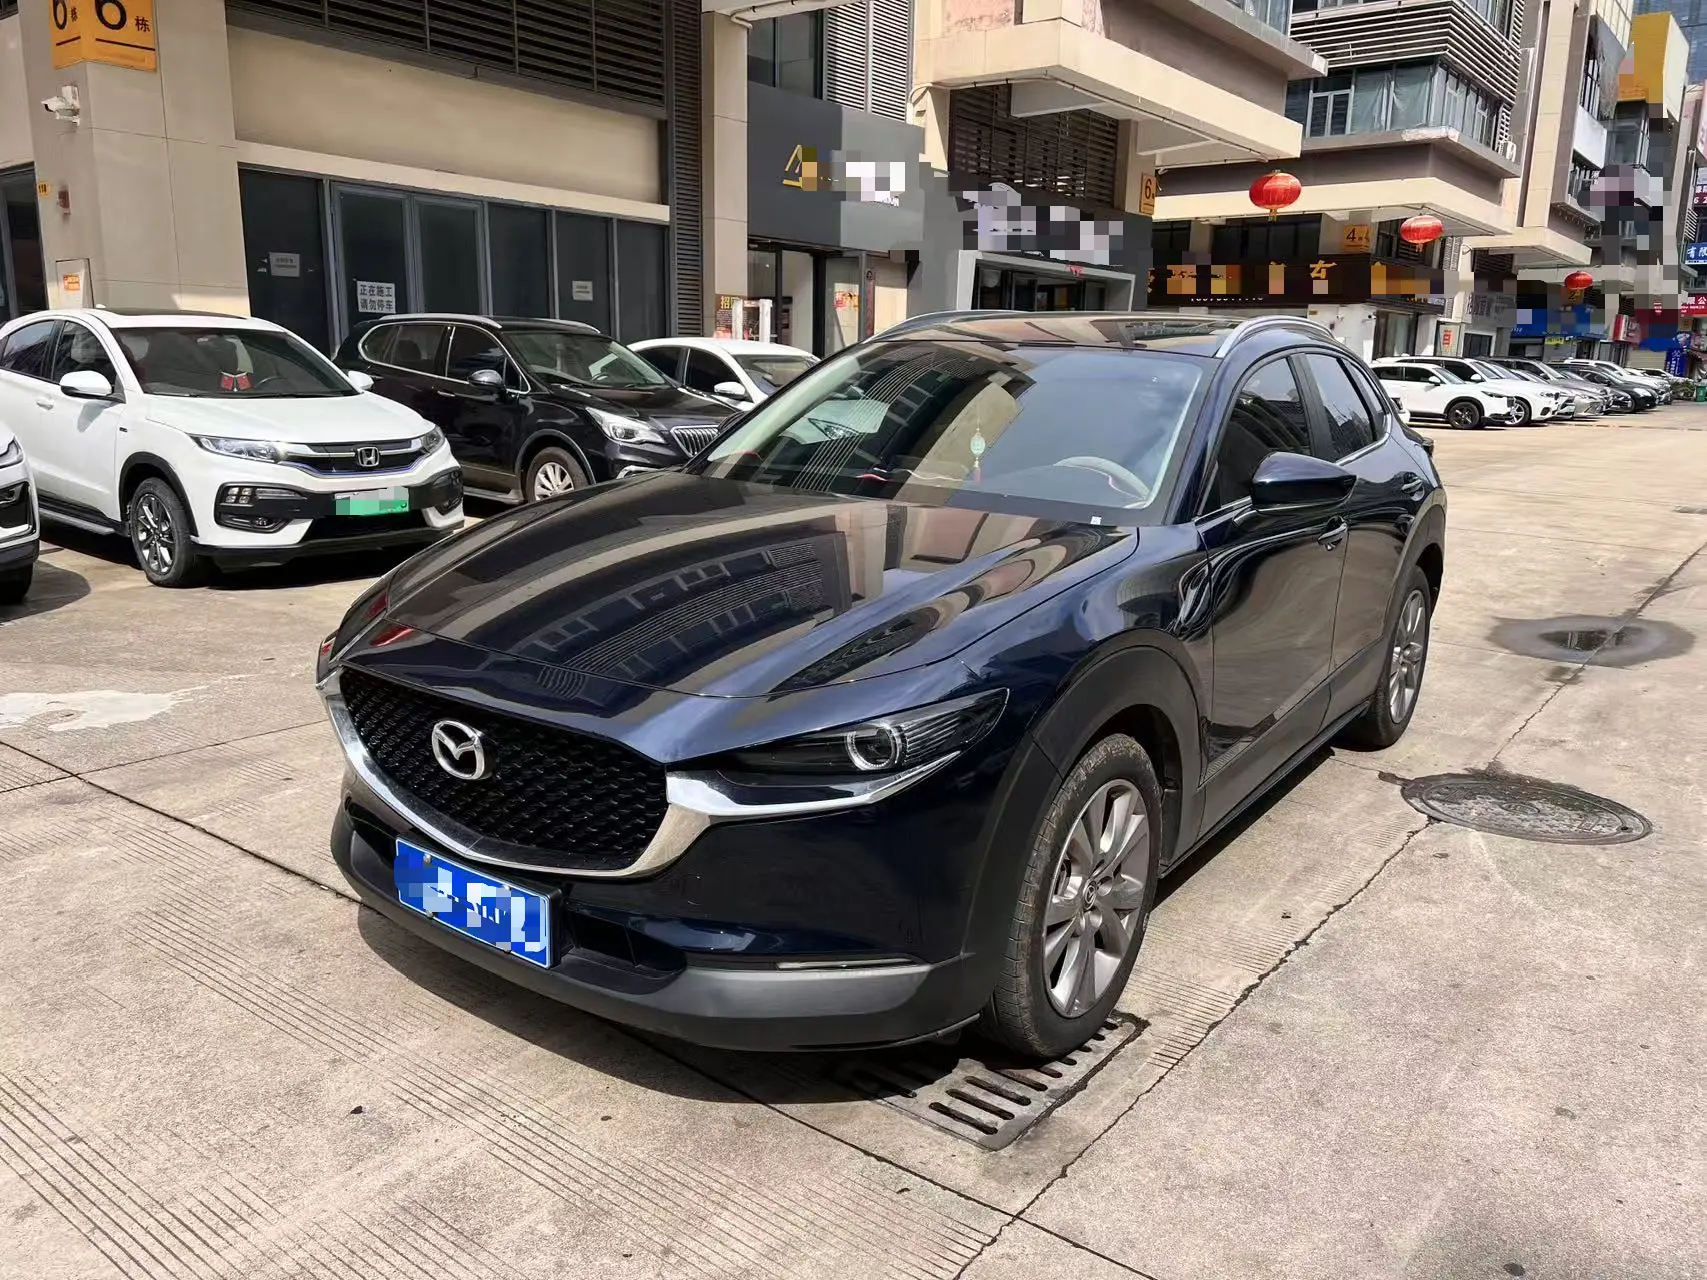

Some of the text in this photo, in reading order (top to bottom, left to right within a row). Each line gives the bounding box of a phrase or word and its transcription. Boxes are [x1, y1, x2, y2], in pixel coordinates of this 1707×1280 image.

[360, 284, 393, 297] 正在施工
[360, 298, 394, 311] 请勿停车
